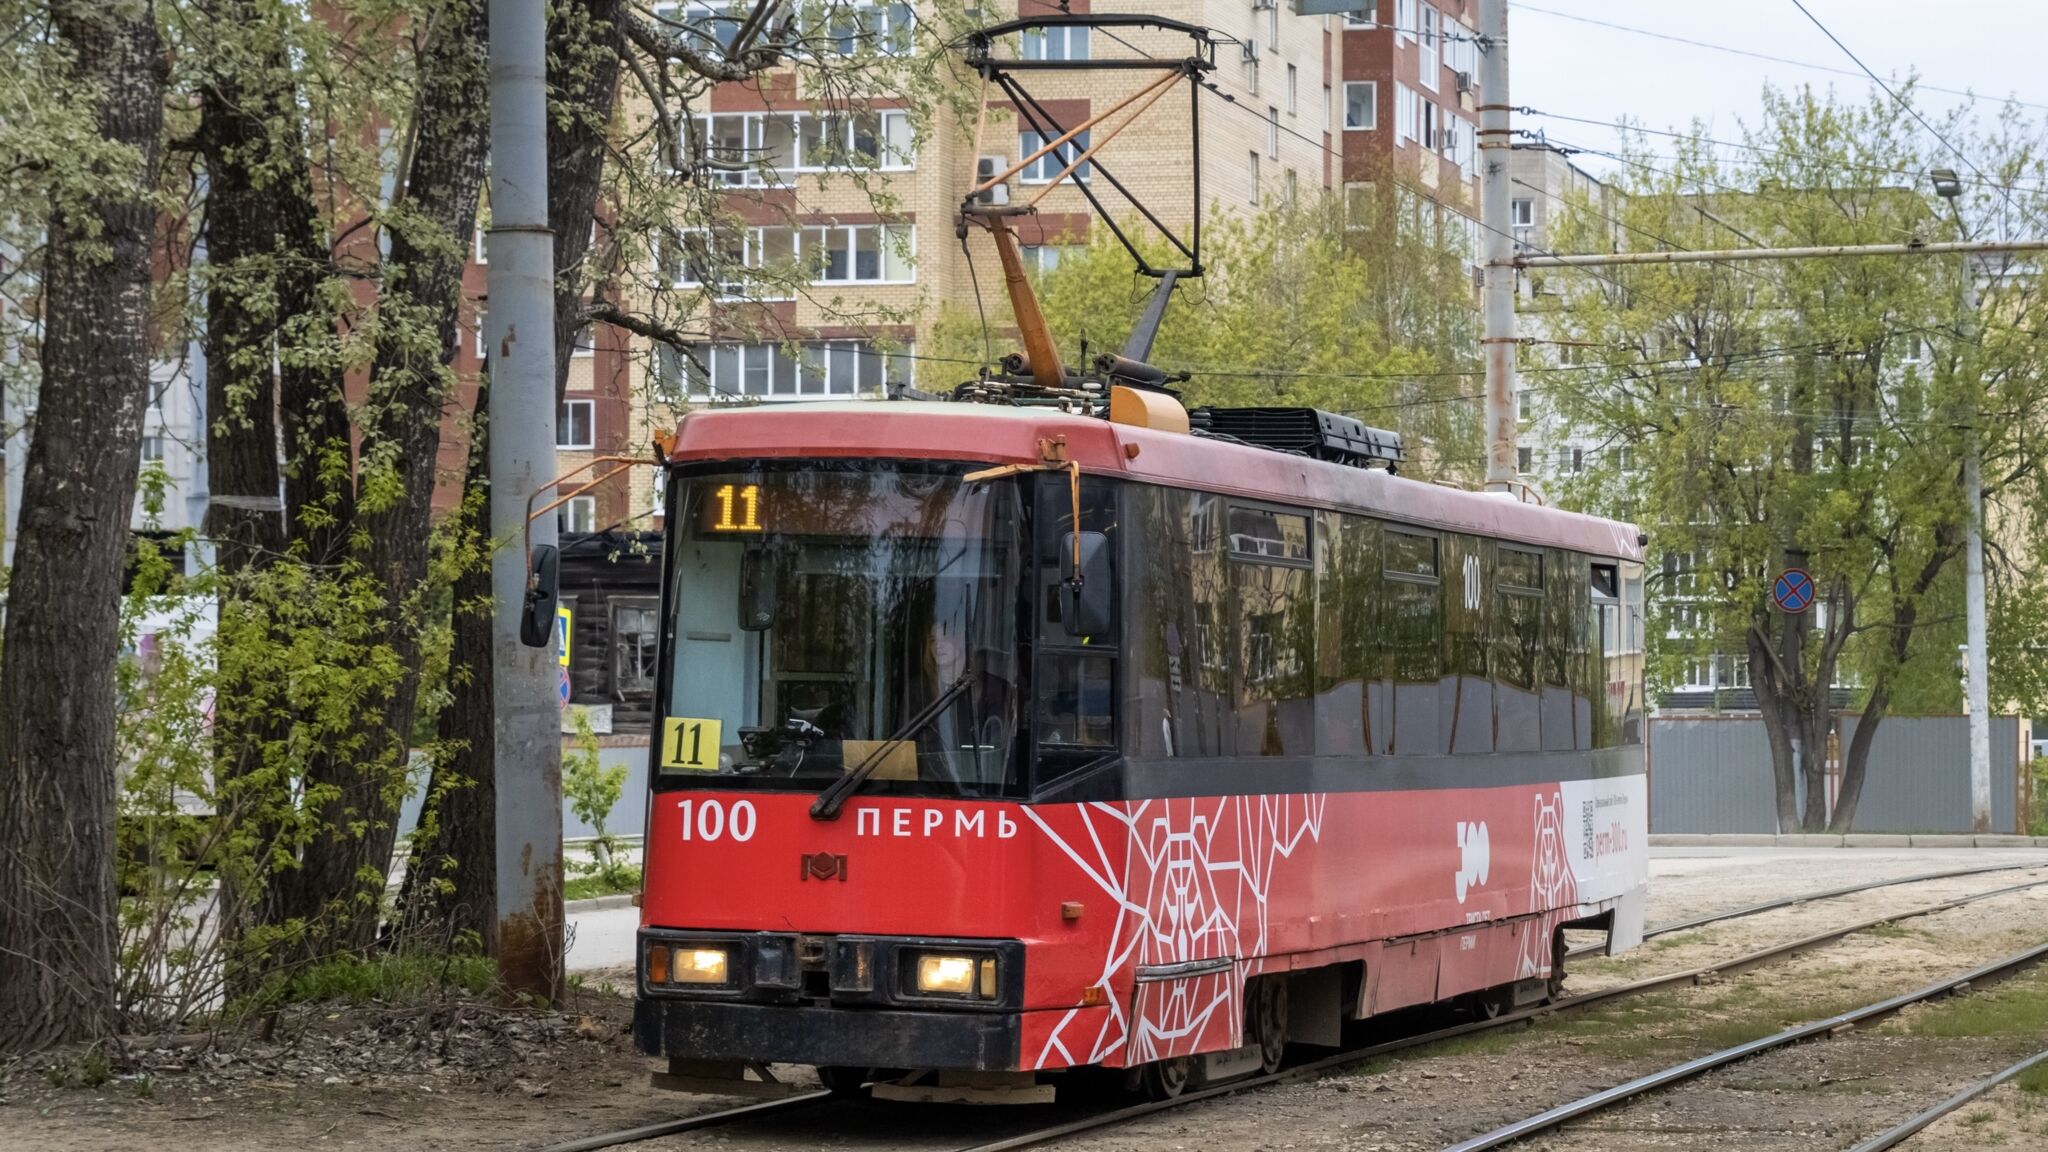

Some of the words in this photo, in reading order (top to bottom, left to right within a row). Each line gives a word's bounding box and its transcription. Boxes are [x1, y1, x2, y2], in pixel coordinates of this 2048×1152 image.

[714, 484, 761, 530] 11
[1462, 553, 1480, 610] 100
[671, 722, 703, 766] 11
[678, 800, 757, 842] 100
[857, 807, 1017, 839] ПЕРМЬ
